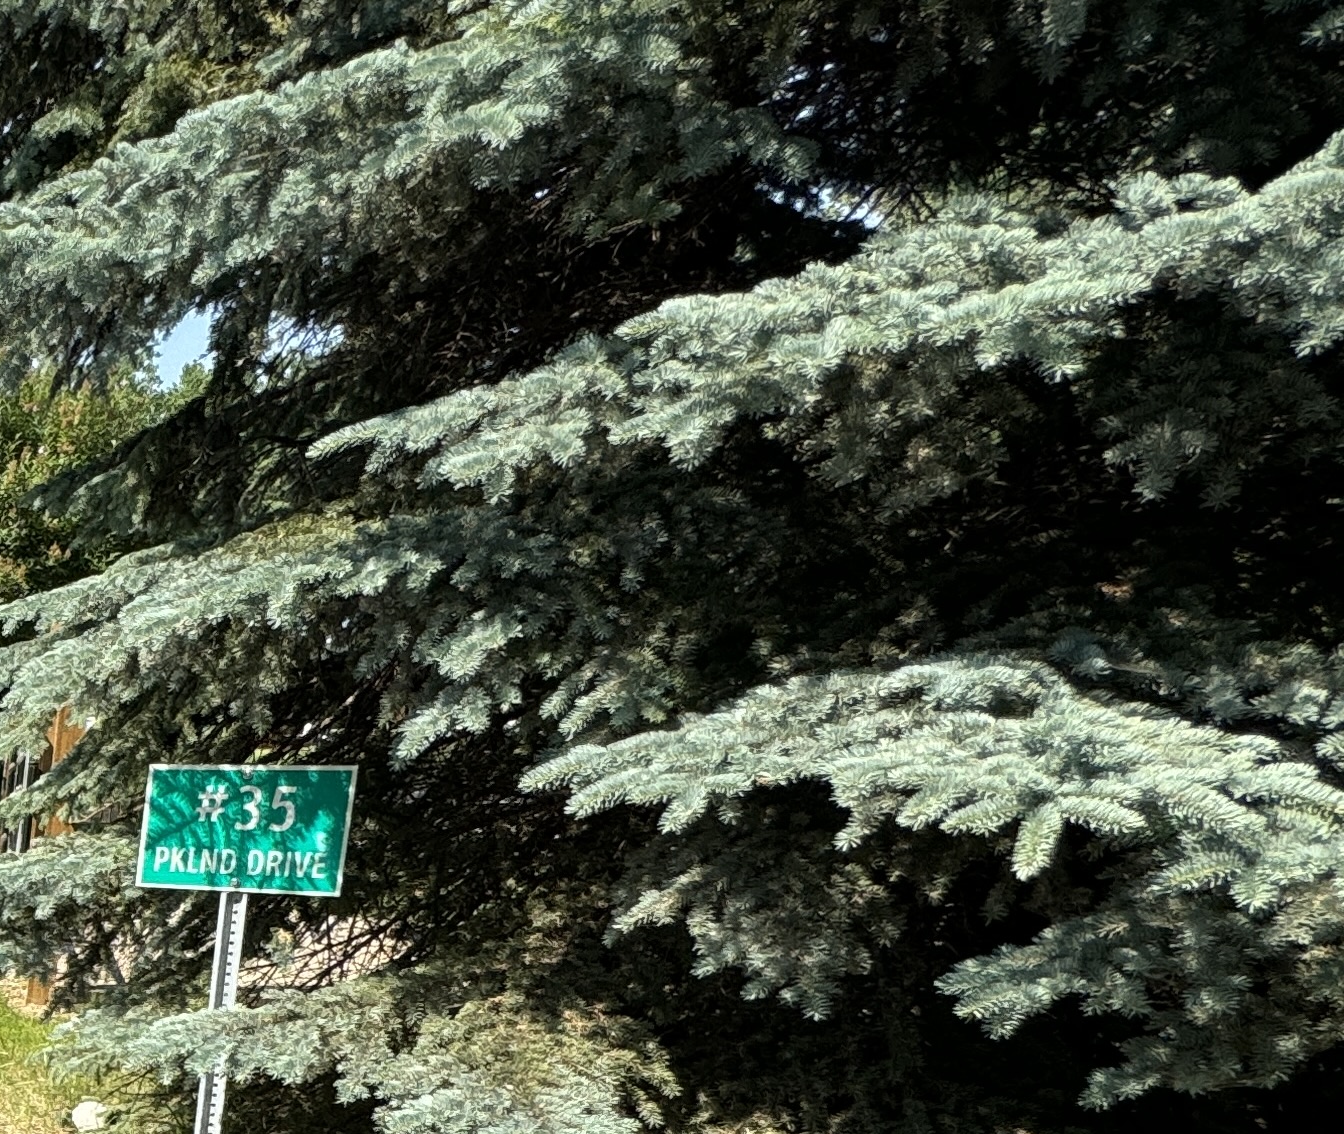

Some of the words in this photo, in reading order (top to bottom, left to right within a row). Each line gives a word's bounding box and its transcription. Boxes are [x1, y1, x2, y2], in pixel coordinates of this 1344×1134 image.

[195, 784, 298, 833] #35
[152, 846, 238, 876] PKLND
[246, 849, 329, 880] DRIVE
